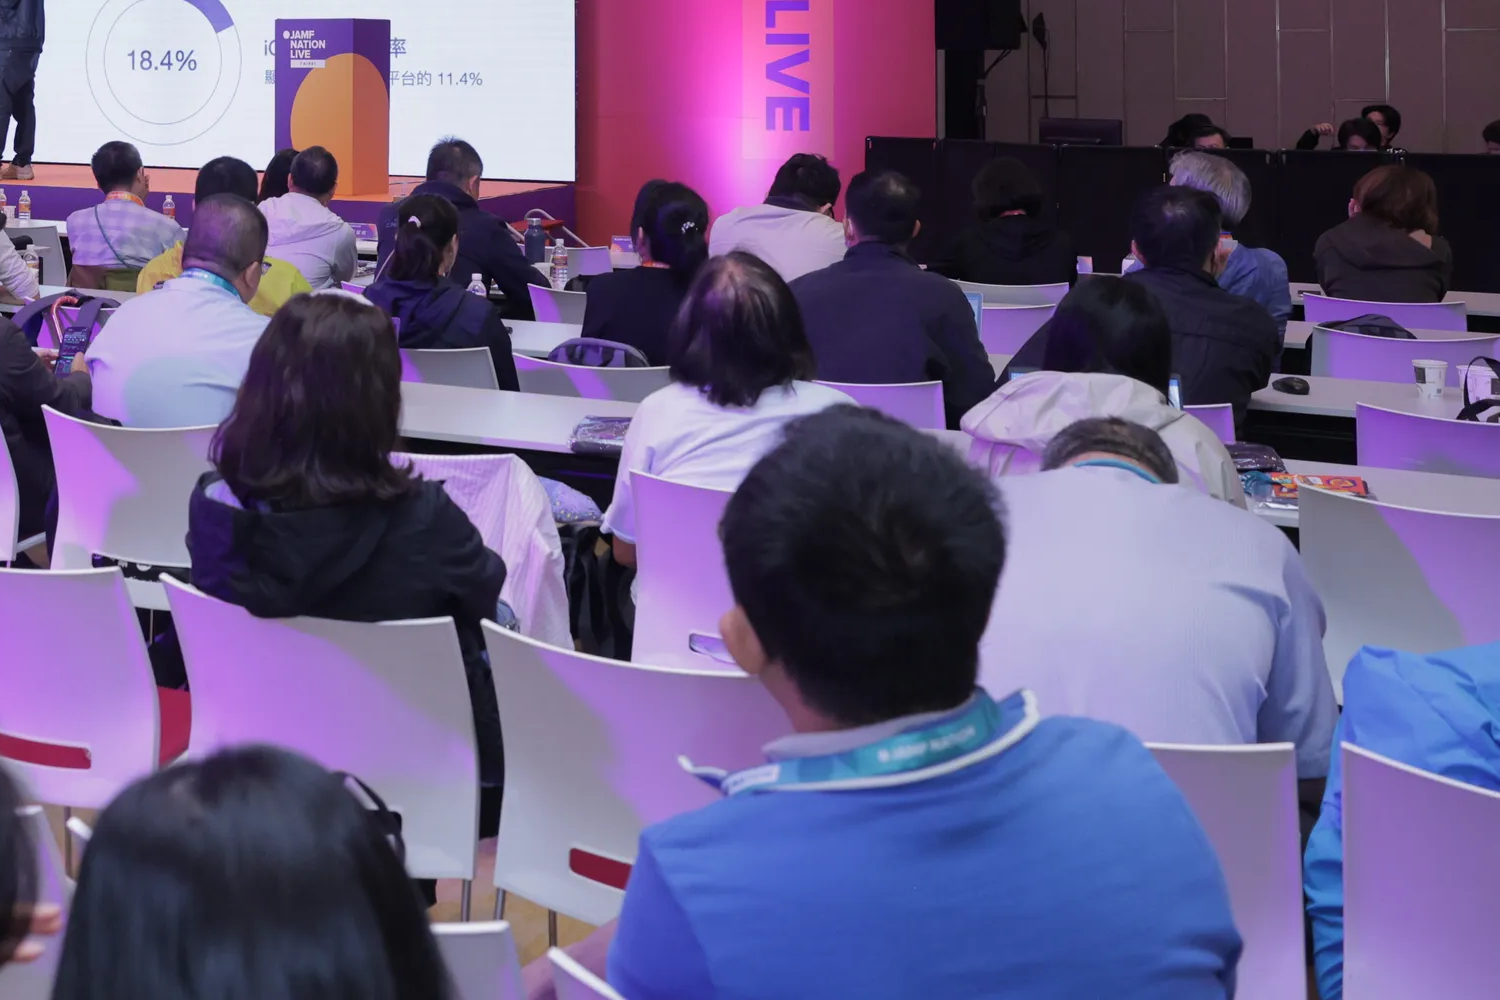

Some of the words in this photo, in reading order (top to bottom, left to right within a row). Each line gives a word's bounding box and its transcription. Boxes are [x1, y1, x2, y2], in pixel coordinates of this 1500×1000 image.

[290, 30, 315, 39] JAMF
[290, 40, 326, 49] NATION
[290, 50, 311, 58] LIVE
[127, 49, 198, 72] 18.4%
[765, 0, 810, 131] LIVE
[437, 71, 484, 86] 11.4%
